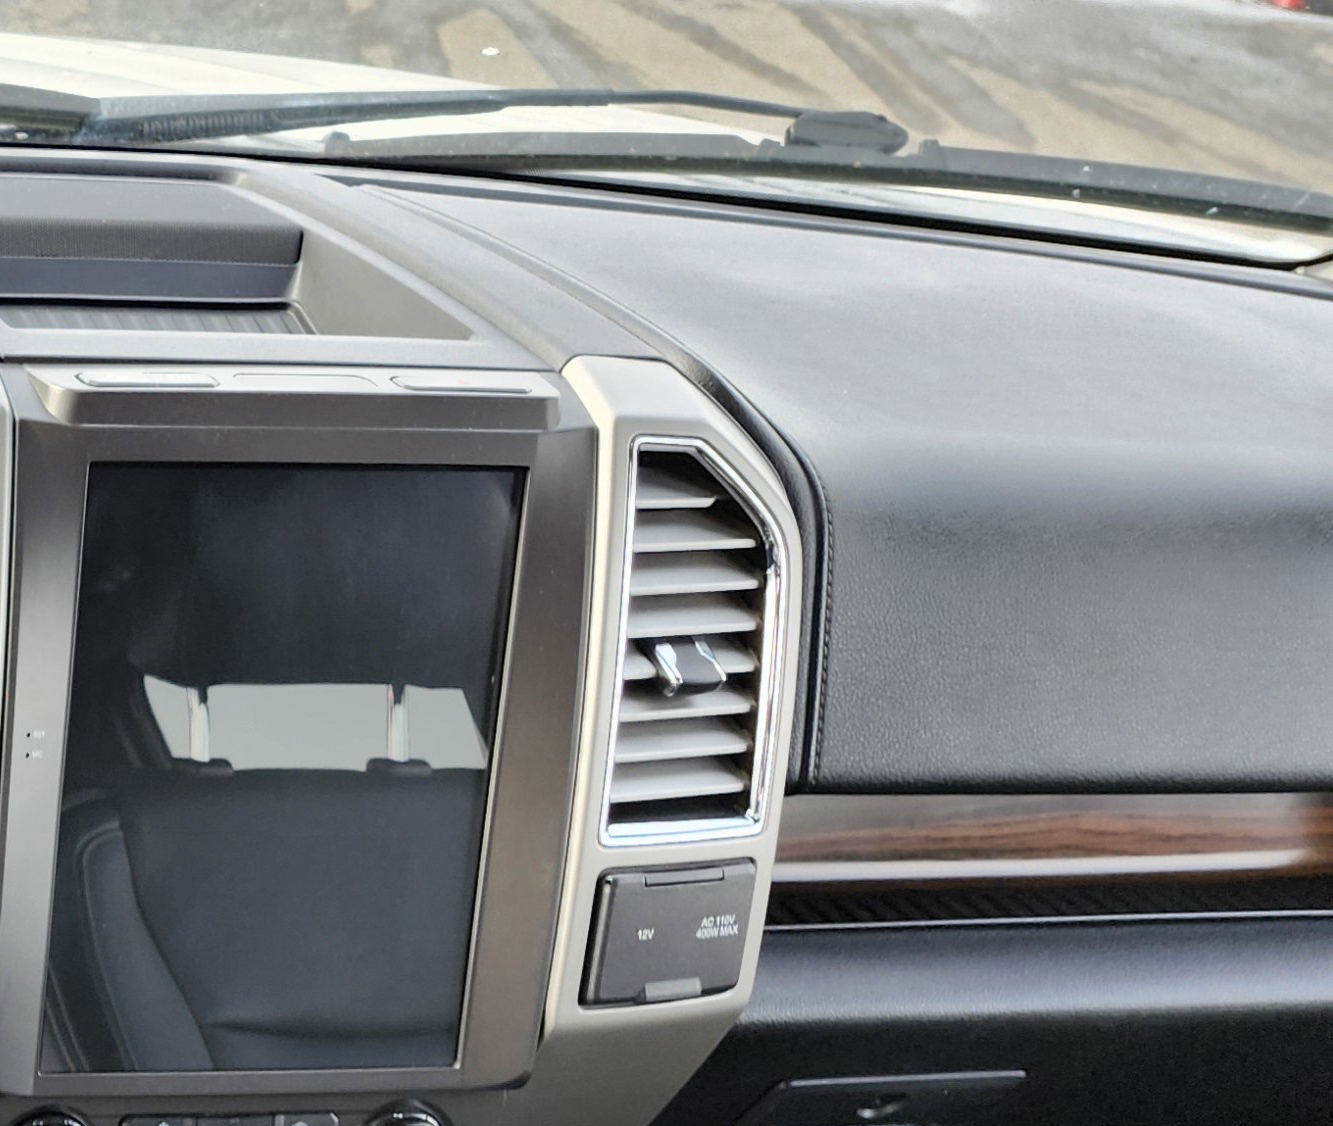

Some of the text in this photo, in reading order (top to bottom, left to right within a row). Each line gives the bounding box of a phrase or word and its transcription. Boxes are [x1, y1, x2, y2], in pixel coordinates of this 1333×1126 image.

[701, 913, 736, 928] AC 110V
[637, 927, 655, 941] 12V
[719, 923, 739, 937] MAX
